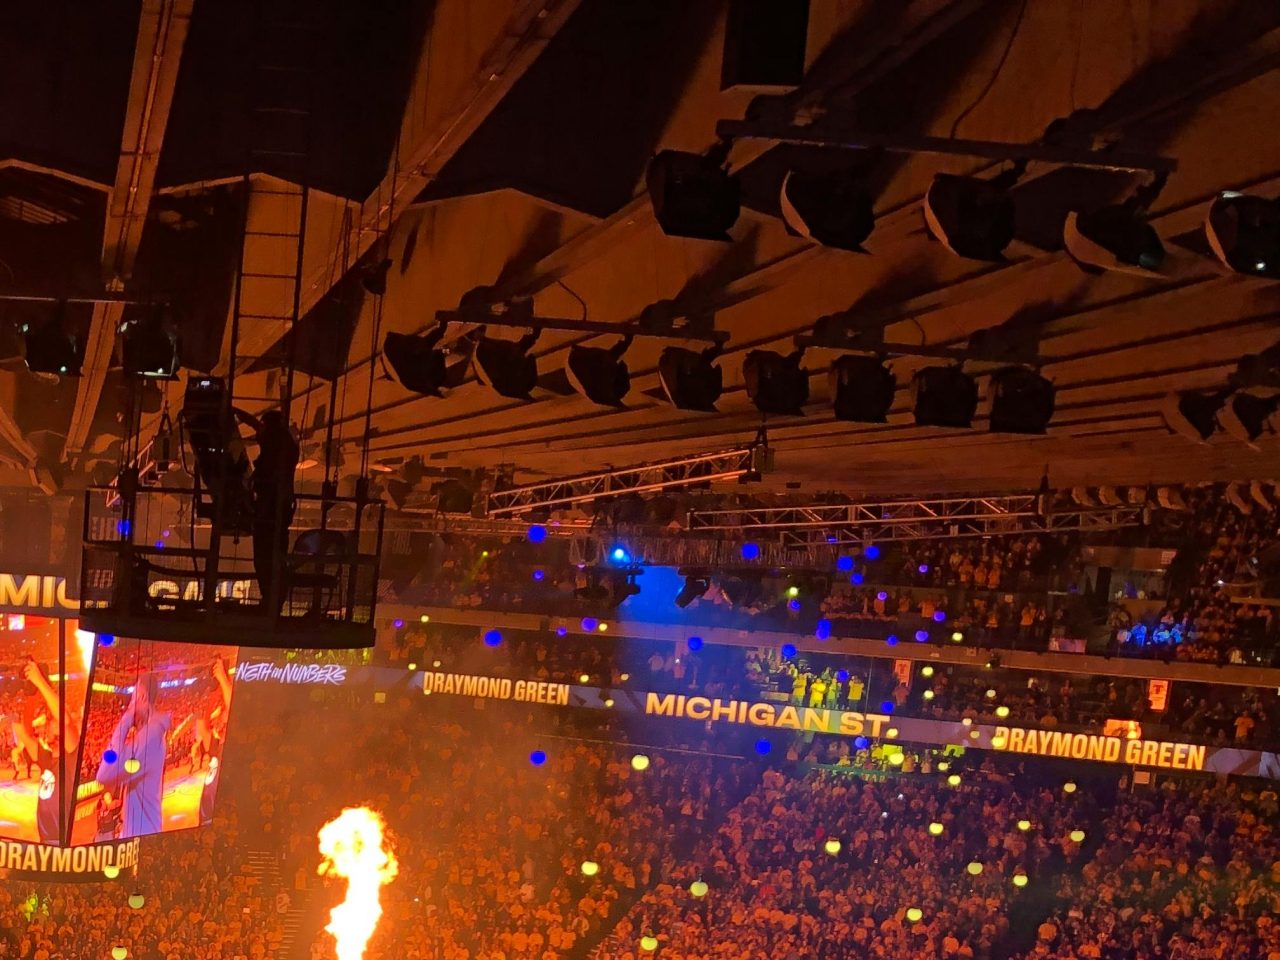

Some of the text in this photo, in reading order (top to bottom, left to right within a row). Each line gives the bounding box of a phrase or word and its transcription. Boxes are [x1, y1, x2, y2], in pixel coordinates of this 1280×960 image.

[424, 671, 570, 706] DRAYMOND GREEN
[645, 692, 891, 738] MICHIGAN ST
[995, 726, 1206, 771] DRAYMOND GREEN
